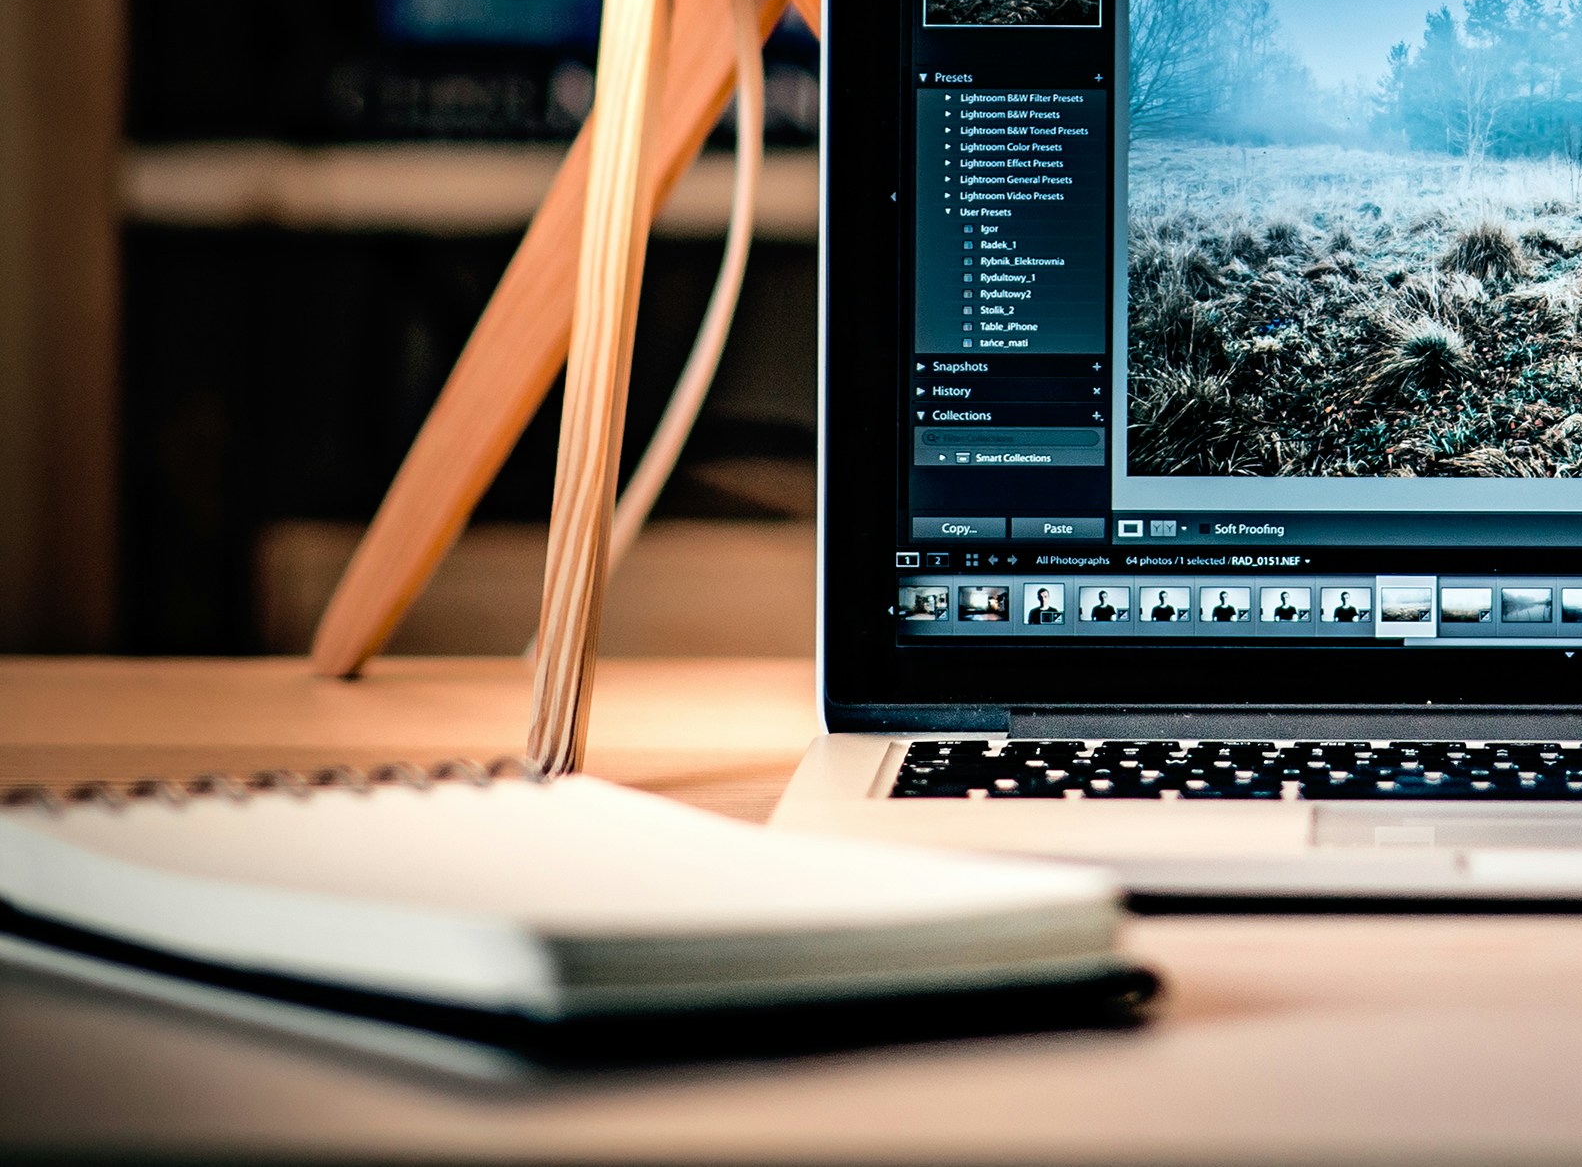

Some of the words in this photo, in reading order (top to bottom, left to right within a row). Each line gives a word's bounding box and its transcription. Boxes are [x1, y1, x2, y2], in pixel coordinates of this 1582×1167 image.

[935, 72, 973, 82] Presets
[961, 93, 1006, 104] Lightroom
[1008, 93, 1029, 102] B&W
[1030, 93, 1052, 102] Filter
[1053, 93, 1084, 102] Presets
[961, 109, 1006, 120] Lightroom
[1008, 109, 1029, 118] B&W
[1030, 109, 1061, 118] Presets
[961, 125, 1006, 136] Lightroom
[1007, 126, 1029, 134] B&W
[1030, 126, 1057, 134] Toned
[1058, 126, 1089, 135] Presets
[960, 142, 1006, 153] Lightroom
[1007, 142, 1031, 151] Color
[1032, 142, 1063, 151] Presets
[960, 158, 1006, 169] Lightroom
[1007, 158, 1032, 167] Effect
[1033, 158, 1064, 167] Presets
[960, 174, 1006, 185] Lightroom
[1007, 175, 1041, 184] General
[1042, 175, 1073, 184] Presets
[960, 191, 1006, 202] Lightroom
[1007, 191, 1033, 200] Video
[1034, 191, 1065, 200] Presets
[960, 207, 980, 216] User
[981, 207, 1012, 216] Presets
[981, 224, 999, 234] Igor
[981, 240, 1017, 250] Radek_1
[981, 256, 1065, 267] Rybnik_Elektrownia
[981, 305, 1015, 315] Stolik_2
[980, 321, 1039, 331] Table_iPhone
[933, 360, 989, 373] Snapshots
[933, 385, 972, 398] History
[933, 409, 992, 420] Collections
[976, 453, 1003, 462] Smart
[1003, 453, 1052, 462] Collections
[1044, 523, 1073, 533] Paste
[1215, 523, 1237, 534] Soft
[1239, 523, 1285, 537] Proofing
[1036, 555, 1049, 564] All
[1051, 555, 1111, 566] Photographs
[1126, 556, 1138, 564] 64
[1140, 555, 1173, 566] photos
[1187, 556, 1226, 565] selected
